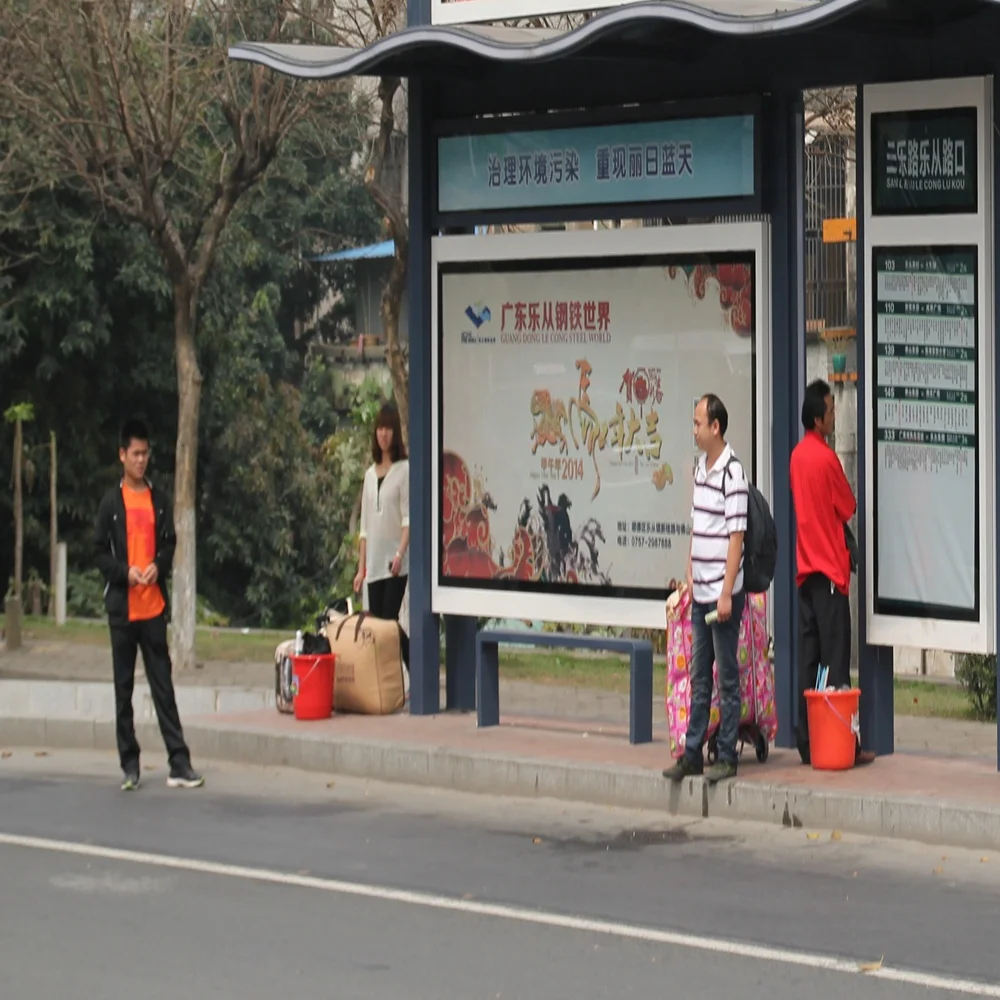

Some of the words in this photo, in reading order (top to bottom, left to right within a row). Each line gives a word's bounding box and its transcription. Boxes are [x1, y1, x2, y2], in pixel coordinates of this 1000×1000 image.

[886, 137, 966, 177] 三乐路乐从路口
[488, 149, 580, 187] 治理环境污染
[596, 143, 693, 181] 重现丽日蓝天
[886, 177, 898, 189] SAN
[924, 179, 942, 191] CONG
[942, 179, 951, 191] LU
[951, 178, 965, 190] KOU
[885, 259, 896, 271] 103
[885, 302, 895, 313] 110
[500, 300, 611, 331] 广东乐从钢铁世界
[501, 331, 522, 345] GUANG
[522, 331, 541, 345] DONG
[550, 331, 569, 345] CONG
[588, 331, 612, 345] WORLD
[884, 429, 895, 441] 333
